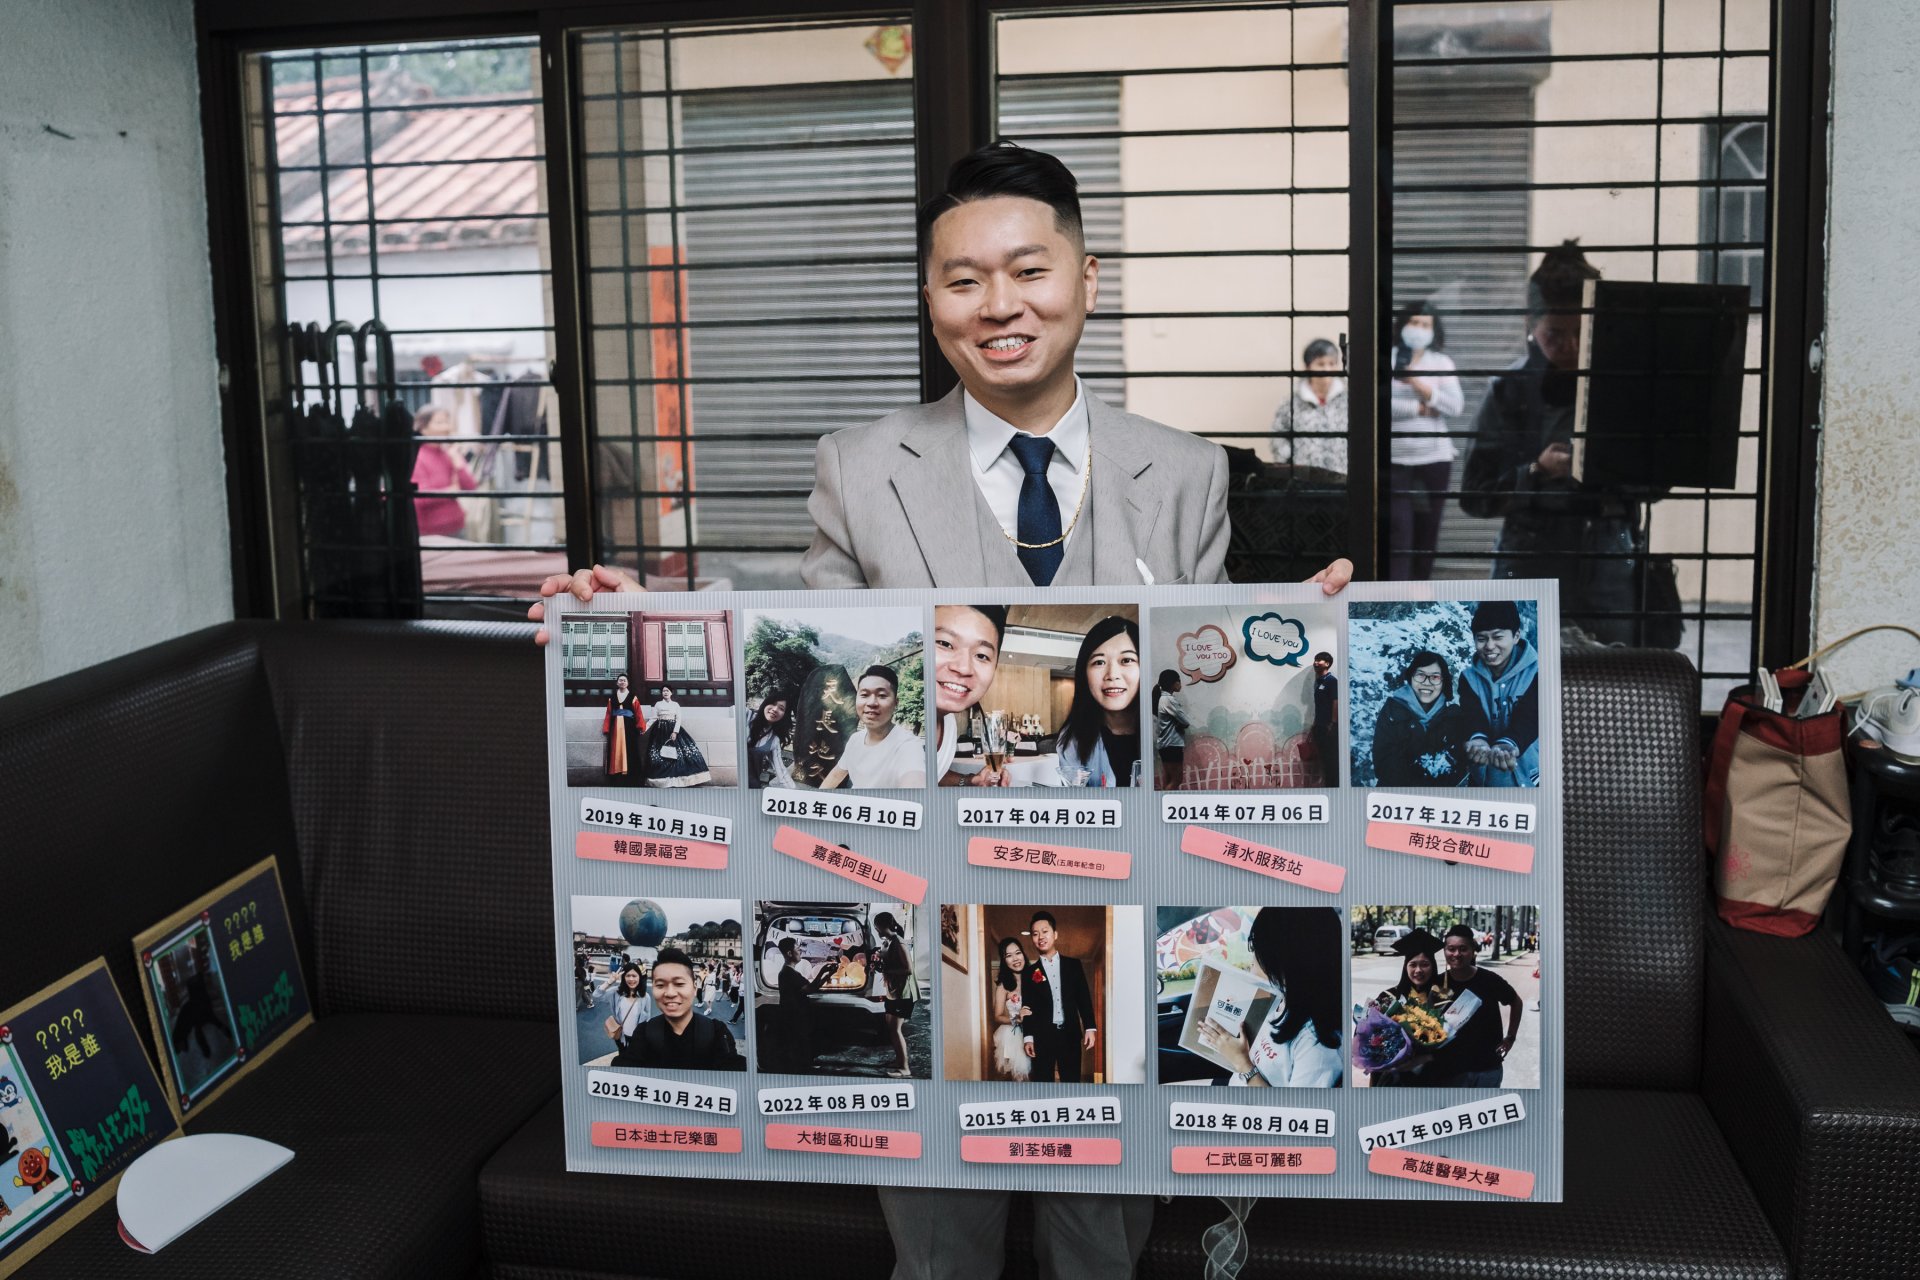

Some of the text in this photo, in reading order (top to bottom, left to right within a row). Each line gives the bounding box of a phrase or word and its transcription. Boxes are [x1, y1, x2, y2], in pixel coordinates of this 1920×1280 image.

[1191, 644, 1213, 652] LOVE
[1257, 631, 1281, 643] LOVE
[1282, 638, 1299, 649] you
[1213, 652, 1228, 660] TOO
[614, 839, 688, 860] 韓國景福宮
[1408, 832, 1491, 859] 南投合歡山
[811, 844, 887, 884] 嘉義阿里山
[1222, 841, 1304, 876] 清水服務站
[228, 923, 265, 962] 我是誰
[45, 1033, 101, 1080] 我是誰
[615, 1127, 718, 1146] 日本迪士尼樂園
[797, 1130, 889, 1150] 大樹區和山里
[1009, 1142, 1073, 1158] 劉荃婚禮
[1205, 1151, 1302, 1168] 仁武區可麗都
[1402, 1157, 1500, 1187] 高雄醫學大學
